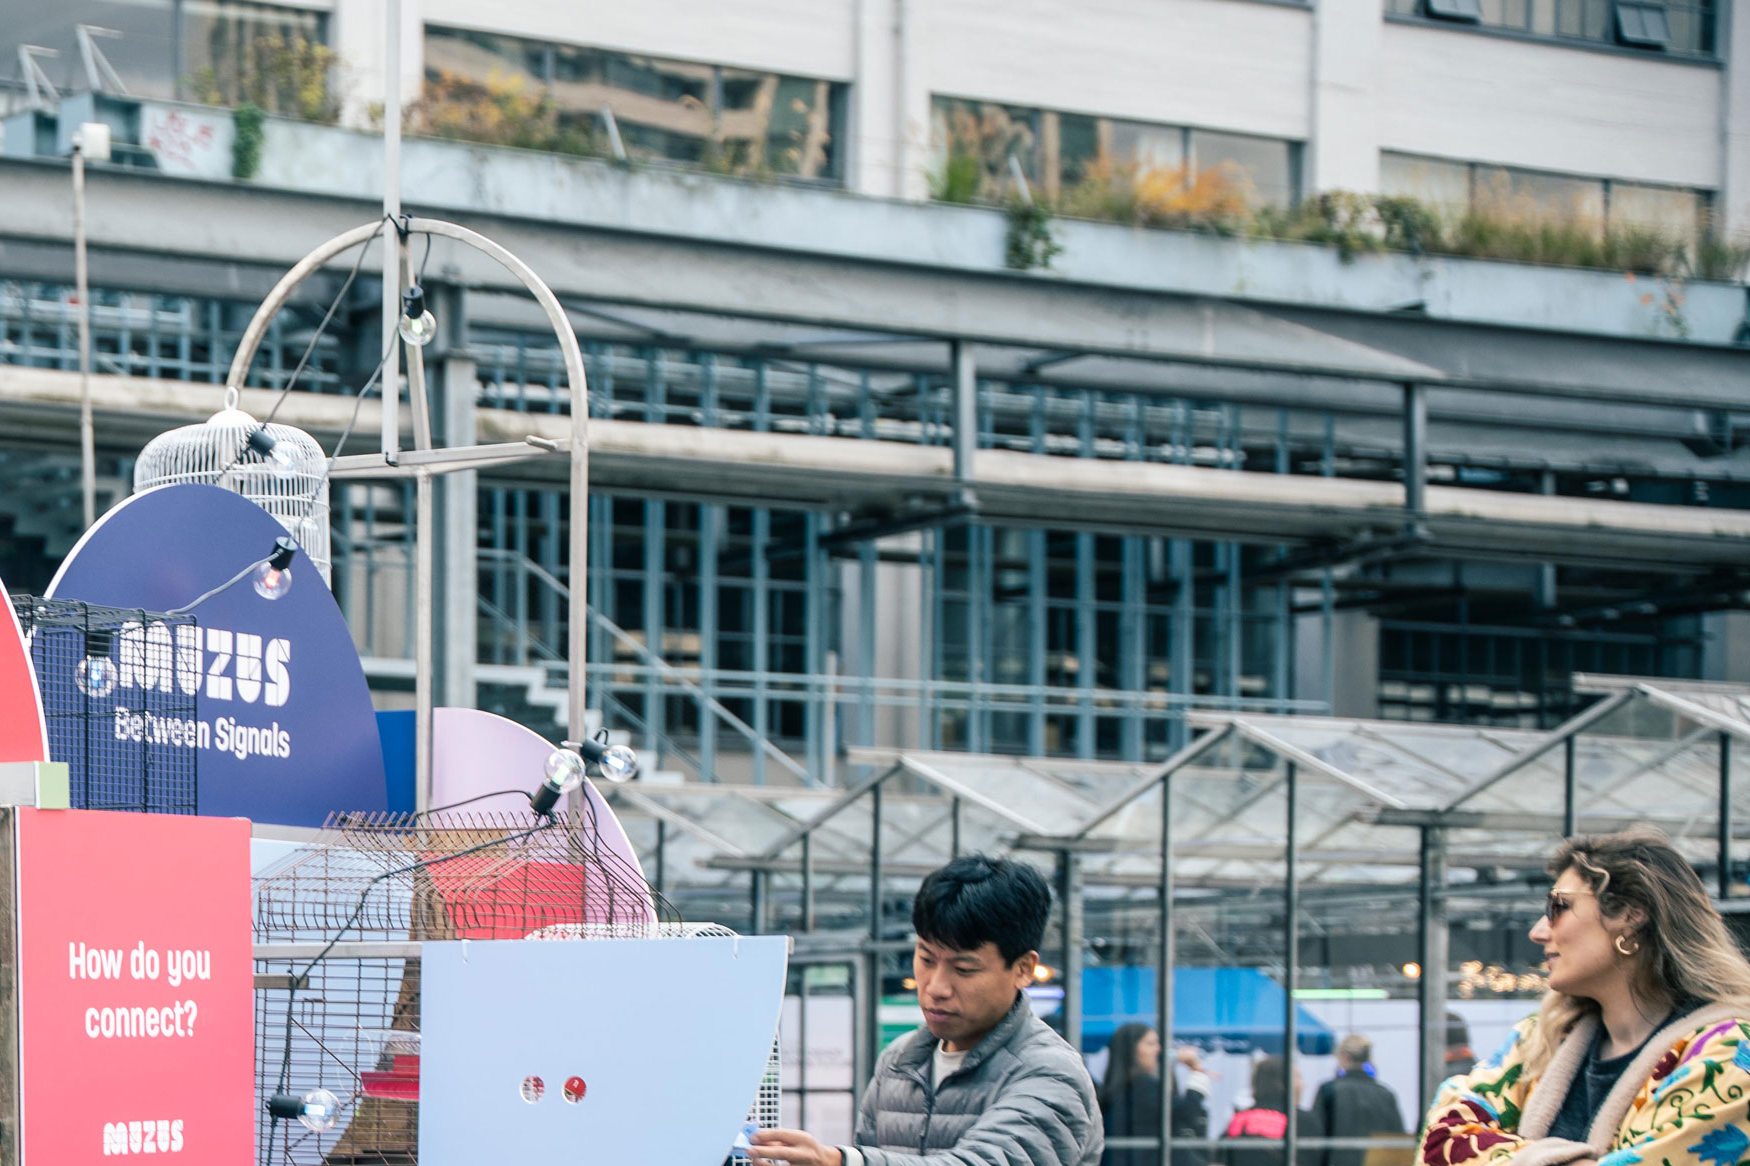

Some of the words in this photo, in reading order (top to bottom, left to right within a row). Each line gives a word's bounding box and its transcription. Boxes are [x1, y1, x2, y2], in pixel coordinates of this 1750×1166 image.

[118, 621, 291, 707] MUZUS
[115, 706, 210, 749] Between
[215, 717, 290, 760] Signals
[69, 942, 123, 980] How
[130, 940, 160, 980] do
[167, 949, 211, 987] you
[85, 1000, 198, 1038] connect?
[103, 1119, 184, 1156] MUZUS
